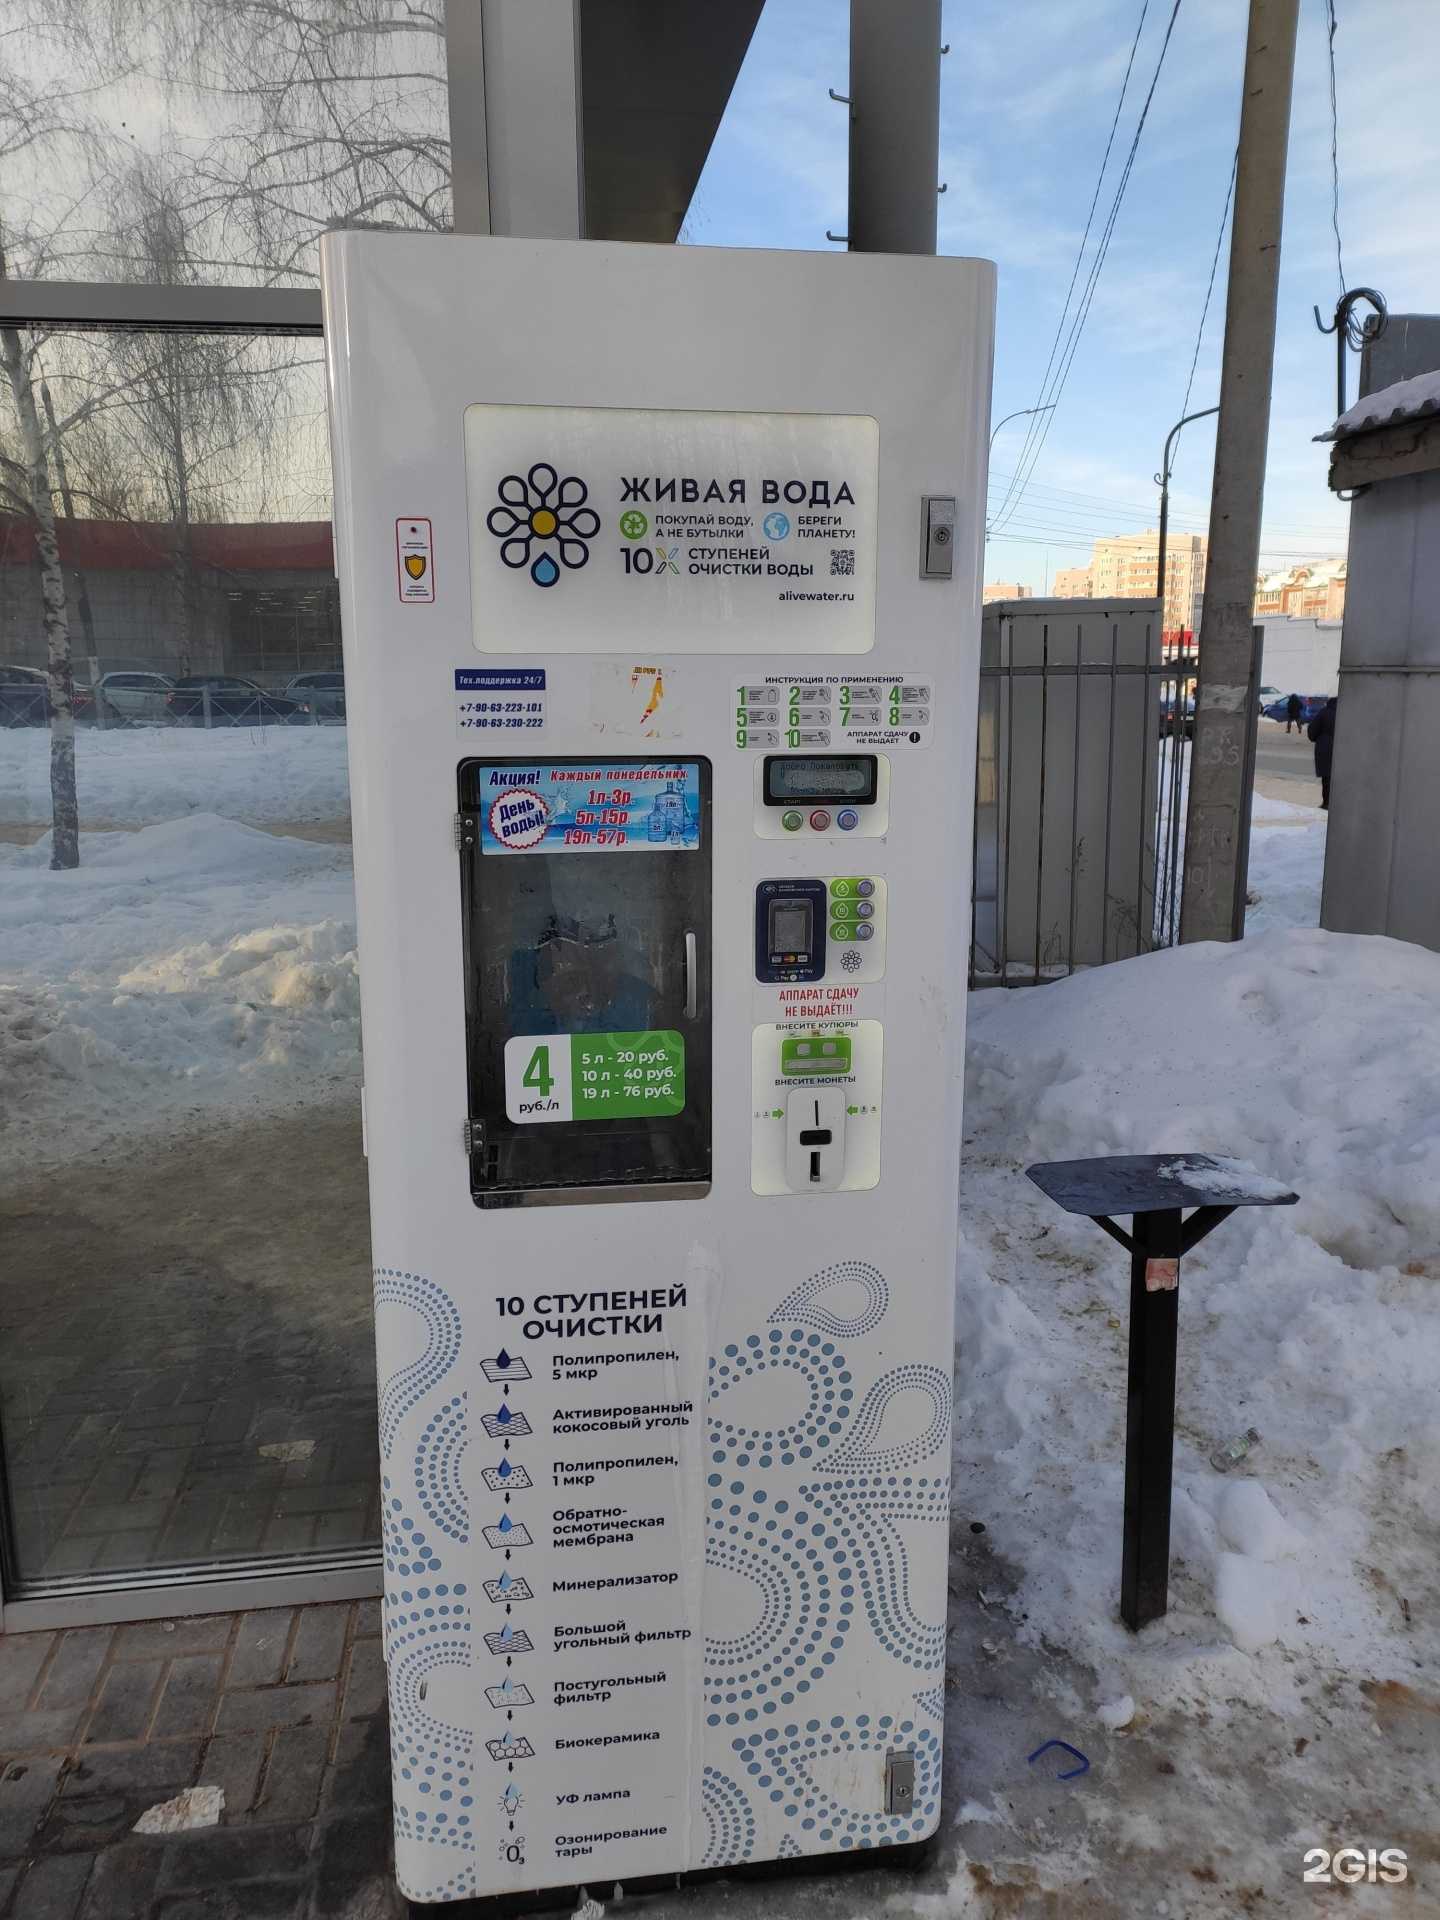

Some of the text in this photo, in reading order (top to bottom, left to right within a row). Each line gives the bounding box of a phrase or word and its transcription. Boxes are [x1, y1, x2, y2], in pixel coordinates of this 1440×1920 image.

[620, 477, 855, 508] ЖИВАЯ ВОДА
[656, 514, 753, 527] ПОКУПАЙ ВОДУ,
[798, 516, 842, 525] БЕРЕГИ
[656, 529, 744, 538] А НЕ БУТЫЛКИ
[798, 529, 855, 538] ПЛАНЕТУ!
[689, 545, 770, 560] СТУПЕНЕЙ
[689, 563, 813, 577] ОЧИСТКИ ВОДЫ
[779, 590, 855, 601] alivewater.ru
[523, 676, 543, 685] 24/7
[765, 676, 823, 684] ИНСТРУКЦИЯ
[841, 676, 904, 684] ПРИМЕНЕНИЮ
[737, 686, 745, 705] 1
[789, 686, 800, 705] 2
[840, 685, 849, 705] 3
[889, 685, 900, 704] 4
[737, 708, 747, 727] 5
[789, 707, 800, 726] 6
[840, 707, 850, 726] 7
[889, 707, 900, 726] 8
[737, 729, 747, 748] 9
[784, 729, 800, 748] 10
[490, 771, 541, 787] Акция!
[551, 769, 602, 782] Каждый
[499, 799, 535, 823] День
[502, 810, 545, 838] воды!
[564, 829, 629, 846] 19л-57р.
[780, 987, 859, 1001] АППАРАТ СДАЧУ
[785, 1002, 853, 1018] НЕ ВЫДАЁТ!!!
[776, 1022, 816, 1031] ВНЕСИТЕ
[582, 1053, 591, 1064] 5
[594, 1055, 604, 1064] л
[617, 1051, 635, 1063] 20
[638, 1049, 669, 1064] руб.
[523, 1046, 554, 1096] 4
[582, 1070, 598, 1082] 10
[601, 1072, 610, 1081] л
[624, 1068, 643, 1079] 40
[647, 1066, 677, 1081] руб.
[775, 1075, 856, 1086] ВНЕСИТЕ МОНЕТЫ
[582, 1088, 597, 1099] 19
[601, 1089, 610, 1098] л
[623, 1085, 641, 1097] 76
[644, 1083, 674, 1099] руб.
[519, 1100, 559, 1114] руб./л
[496, 1283, 687, 1316] 10 СТУПЕНЕЙ
[523, 1314, 663, 1339] ОЧИСТКИ
[553, 1350, 679, 1367] Полипропилен,
[553, 1368, 598, 1381] 5 мкр
[553, 1401, 693, 1420] Активированный
[553, 1416, 690, 1434] кокосовый уголь
[553, 1455, 678, 1473] Полипропилен,
[553, 1475, 595, 1487] 1 мкр
[553, 1507, 627, 1522] Обратно-
[553, 1517, 665, 1535] осмотическая
[553, 1532, 634, 1549] мембрана
[553, 1572, 679, 1592] Минерализатор
[554, 1620, 626, 1637] Большой
[554, 1628, 692, 1652] угольный фильтр
[554, 1672, 667, 1692] Постугольный
[553, 1690, 611, 1706] фильтр
[555, 1731, 660, 1749] Биокерамика
[556, 1788, 631, 1805] УФ лампа
[555, 1825, 667, 1846] Озонирование
[555, 1846, 593, 1858] тары
